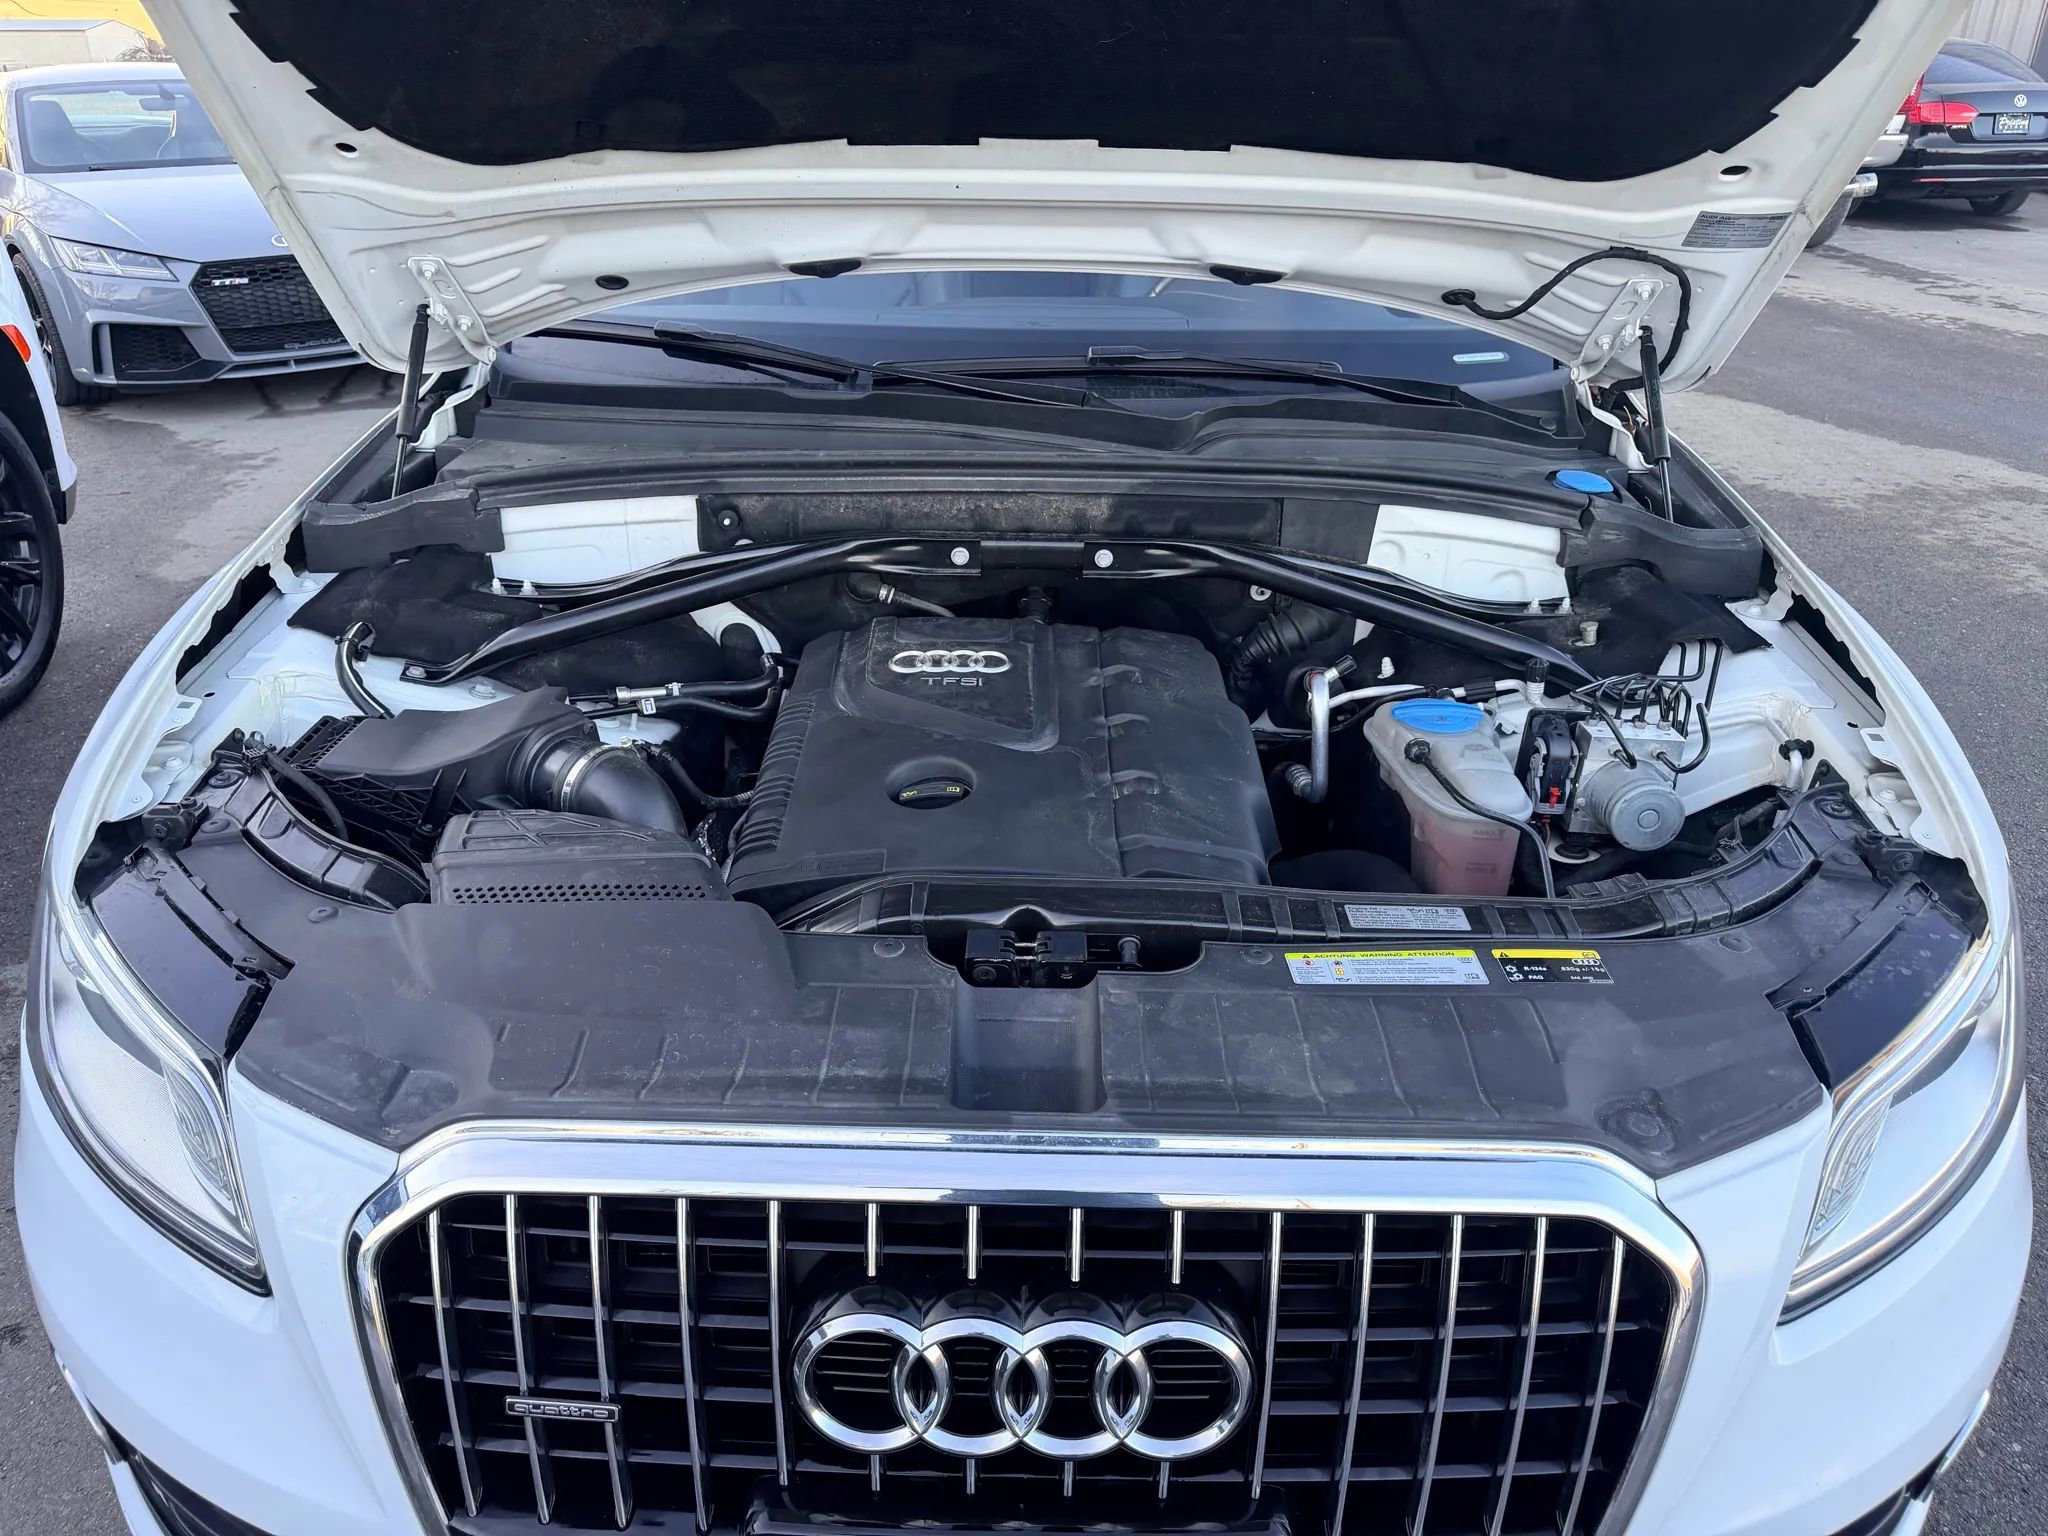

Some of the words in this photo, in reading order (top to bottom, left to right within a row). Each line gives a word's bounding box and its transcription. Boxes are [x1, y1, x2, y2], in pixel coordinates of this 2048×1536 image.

[283, 337, 346, 349] quattr
[920, 677, 983, 686] TFSI
[513, 1403, 609, 1418] quattro
